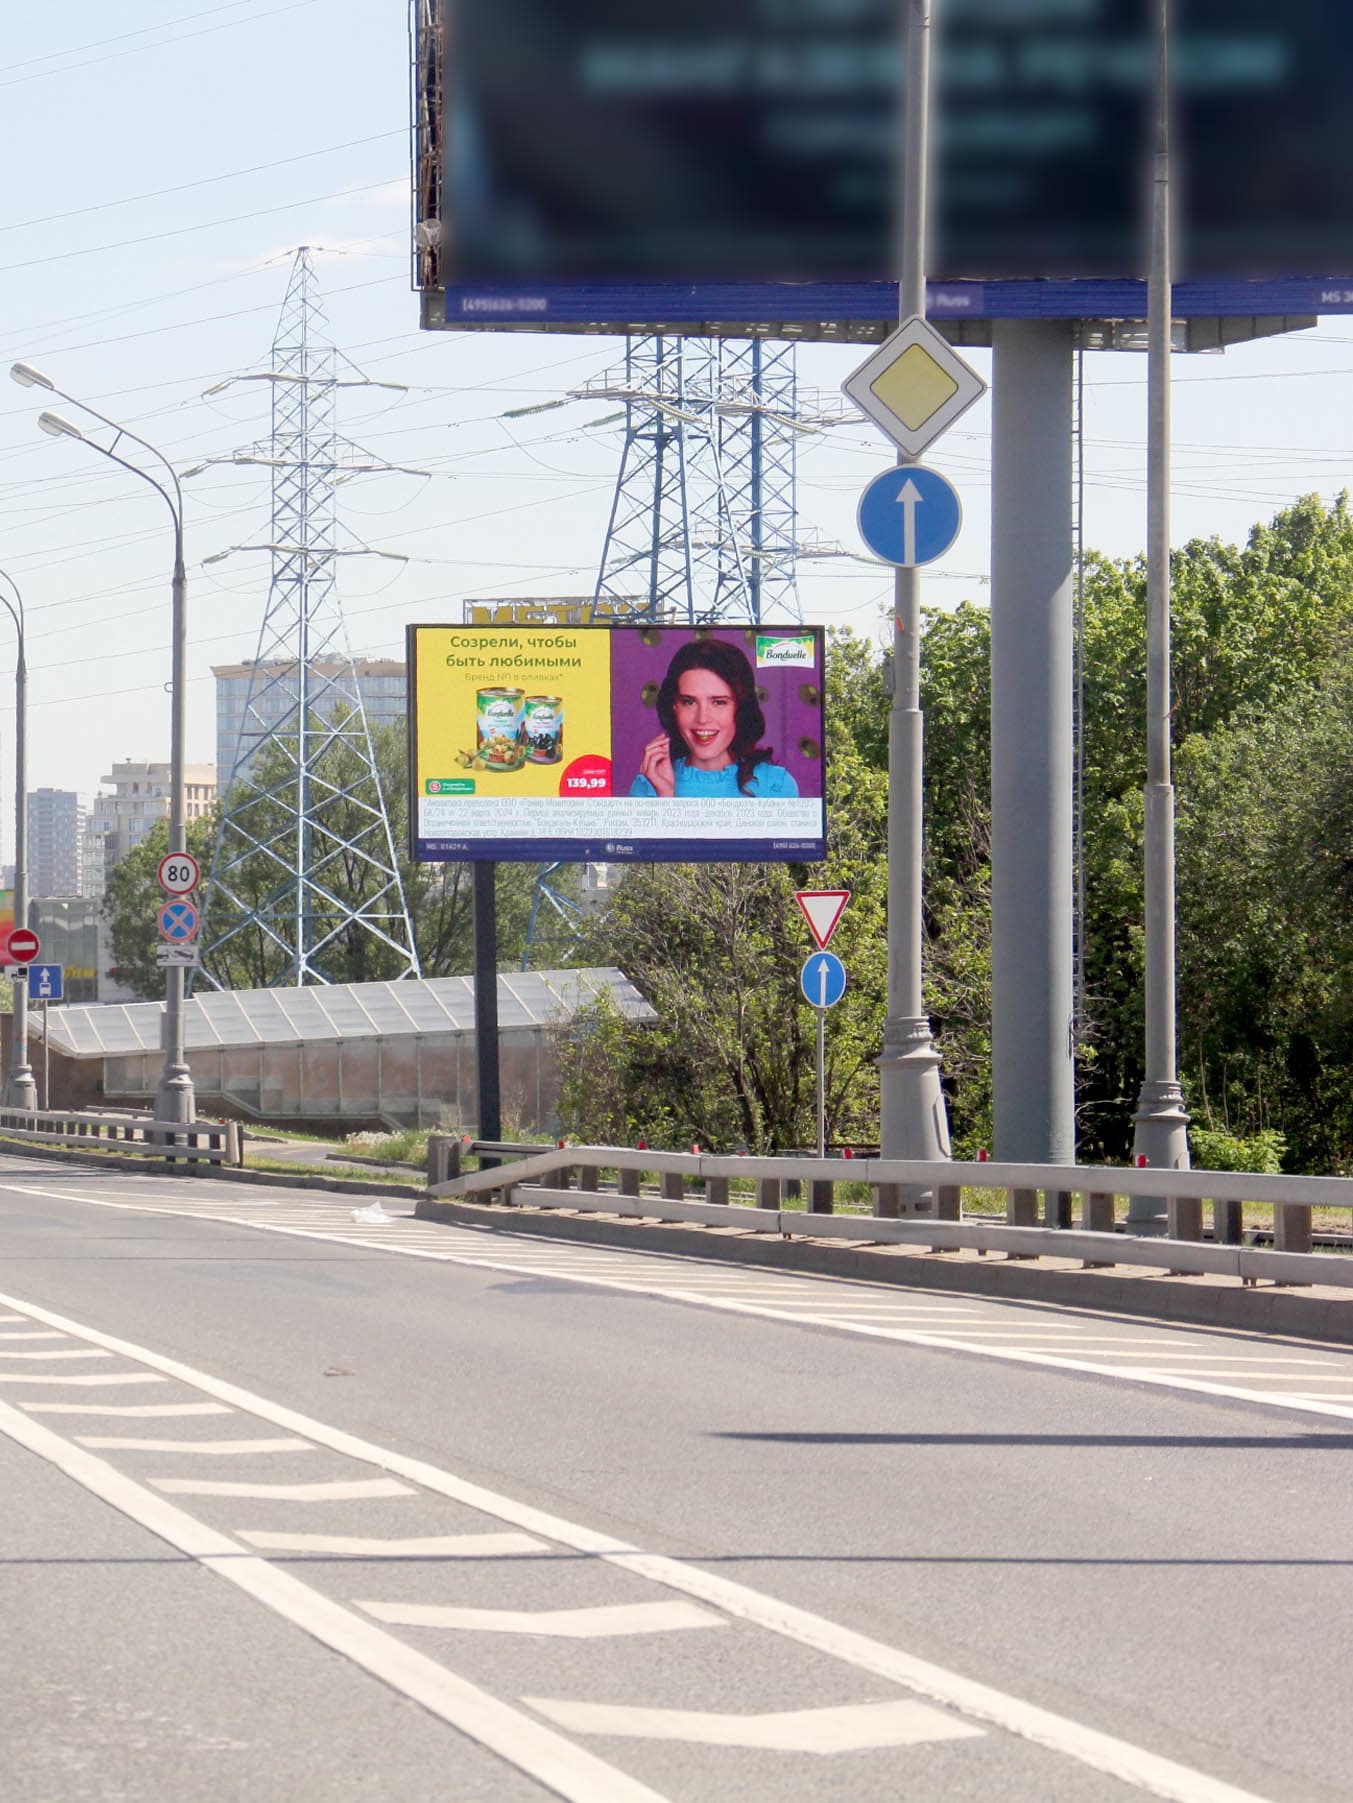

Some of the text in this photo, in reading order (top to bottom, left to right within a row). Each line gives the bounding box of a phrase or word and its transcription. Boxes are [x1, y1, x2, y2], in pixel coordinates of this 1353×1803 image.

[450, 635, 577, 650] Созрели, чтобы
[446, 654, 581, 667] быть любимыми
[766, 649, 806, 660] Bonduelle
[566, 777, 606, 790] 139,99
[167, 865, 190, 882] 80
